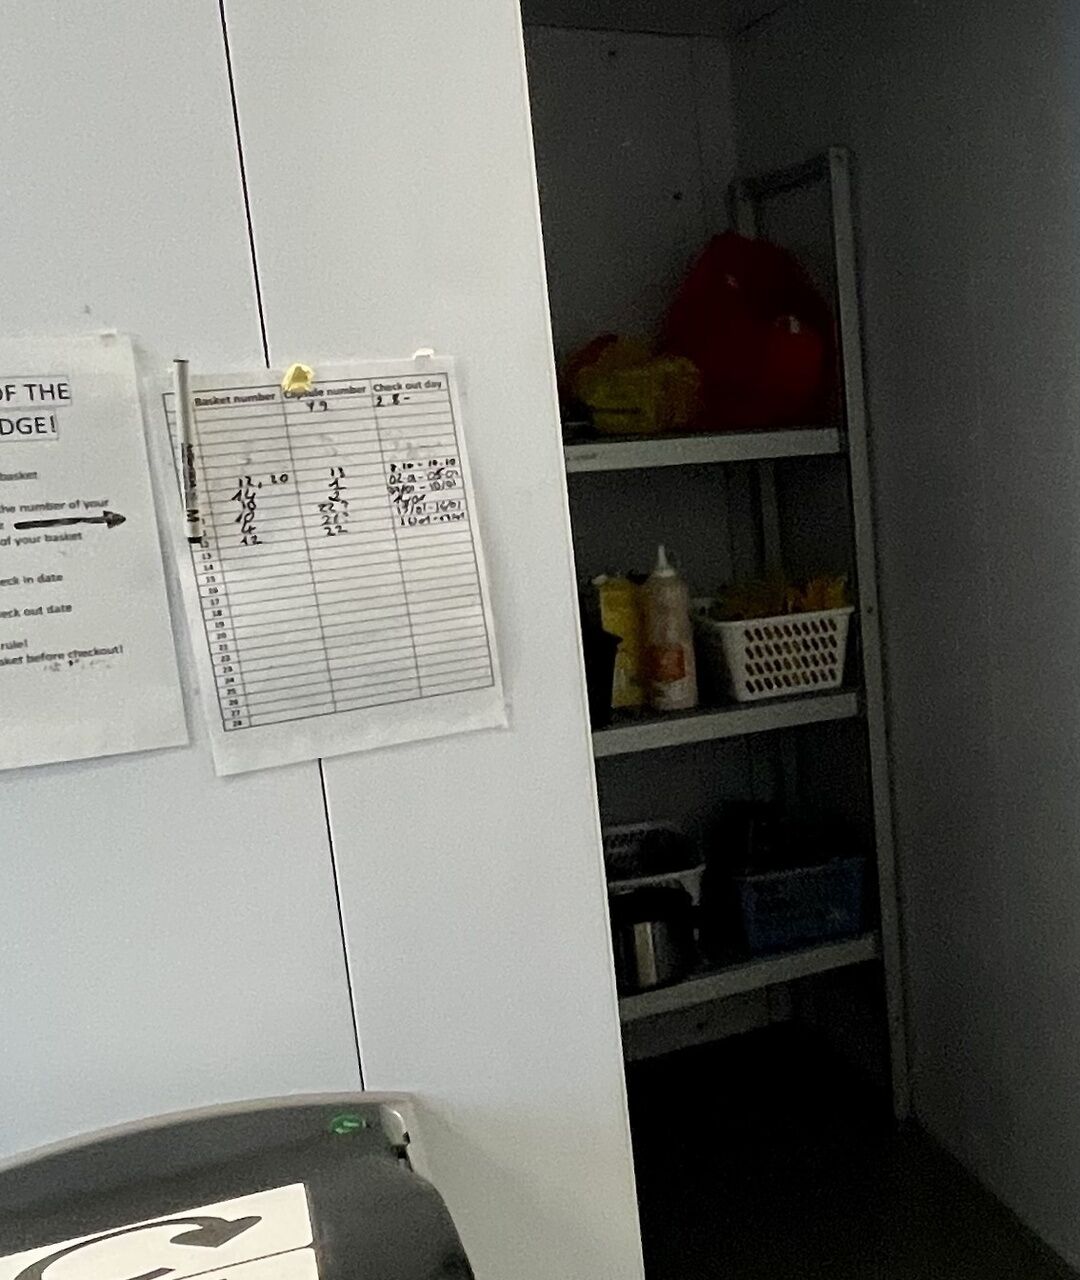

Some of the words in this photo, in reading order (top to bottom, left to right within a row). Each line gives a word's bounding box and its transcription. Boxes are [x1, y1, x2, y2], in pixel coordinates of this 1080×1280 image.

[0, 384, 16, 401] F
[23, 382, 71, 401] THE
[326, 385, 367, 396] number
[372, 382, 403, 393] Check
[405, 381, 423, 391] out
[424, 379, 442, 390] day
[234, 392, 276, 403] number
[20, 502, 66, 513] number
[68, 499, 80, 510] of
[36, 572, 64, 584] date
[46, 604, 73, 614] date
